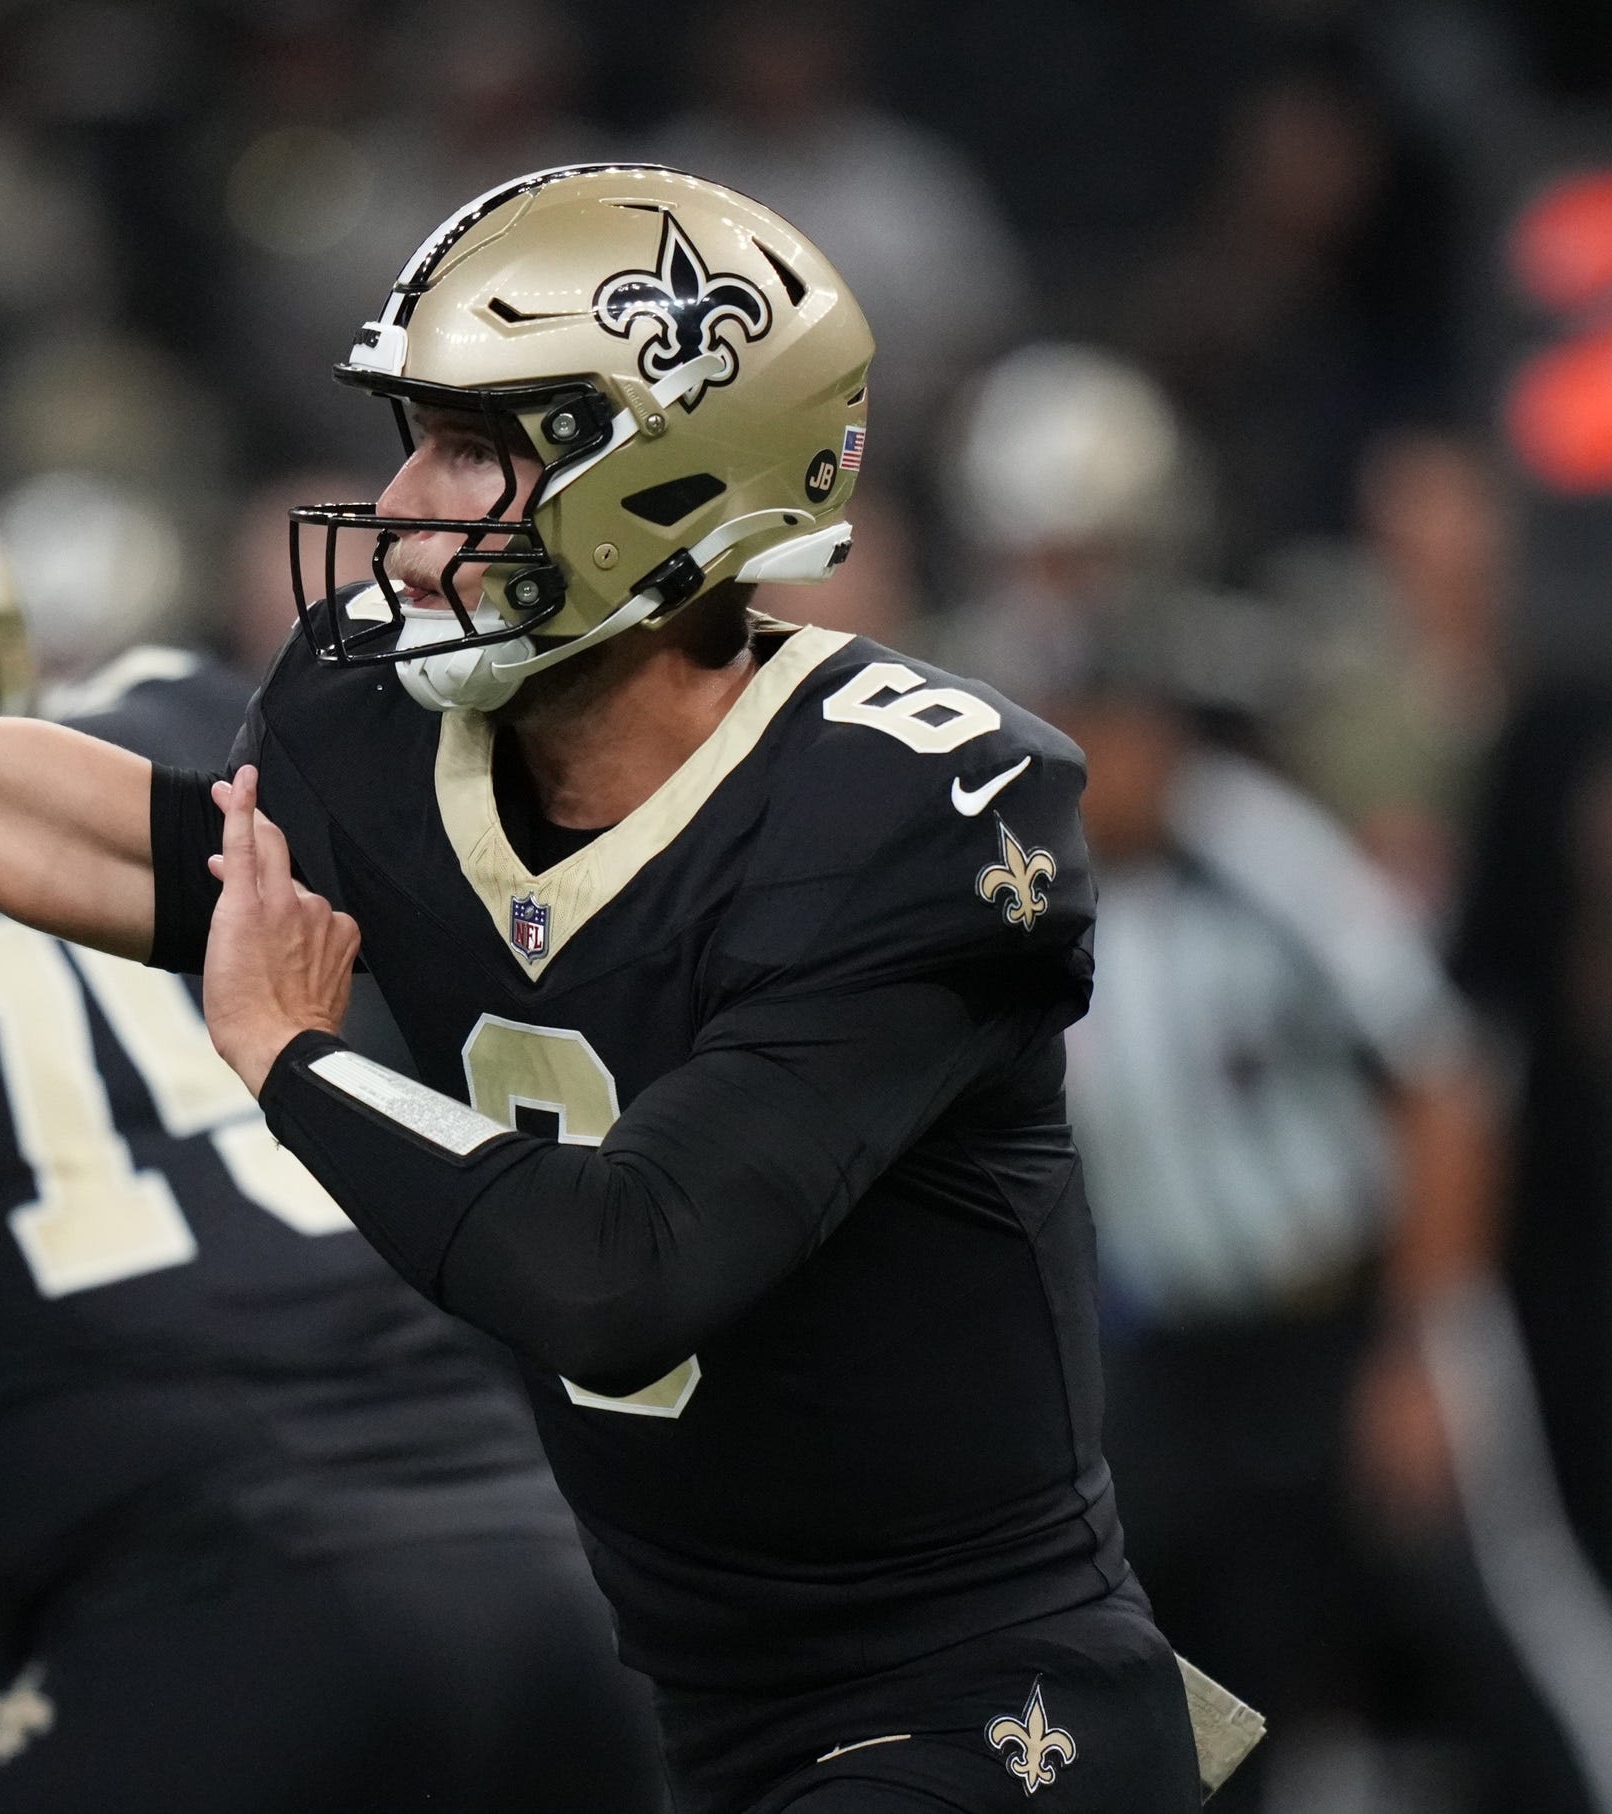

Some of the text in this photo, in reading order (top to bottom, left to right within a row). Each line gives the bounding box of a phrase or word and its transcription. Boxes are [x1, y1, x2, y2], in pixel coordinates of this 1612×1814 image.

[809, 462, 834, 491] JB
[823, 662, 1001, 754] 6
[515, 921, 542, 950] NFL
